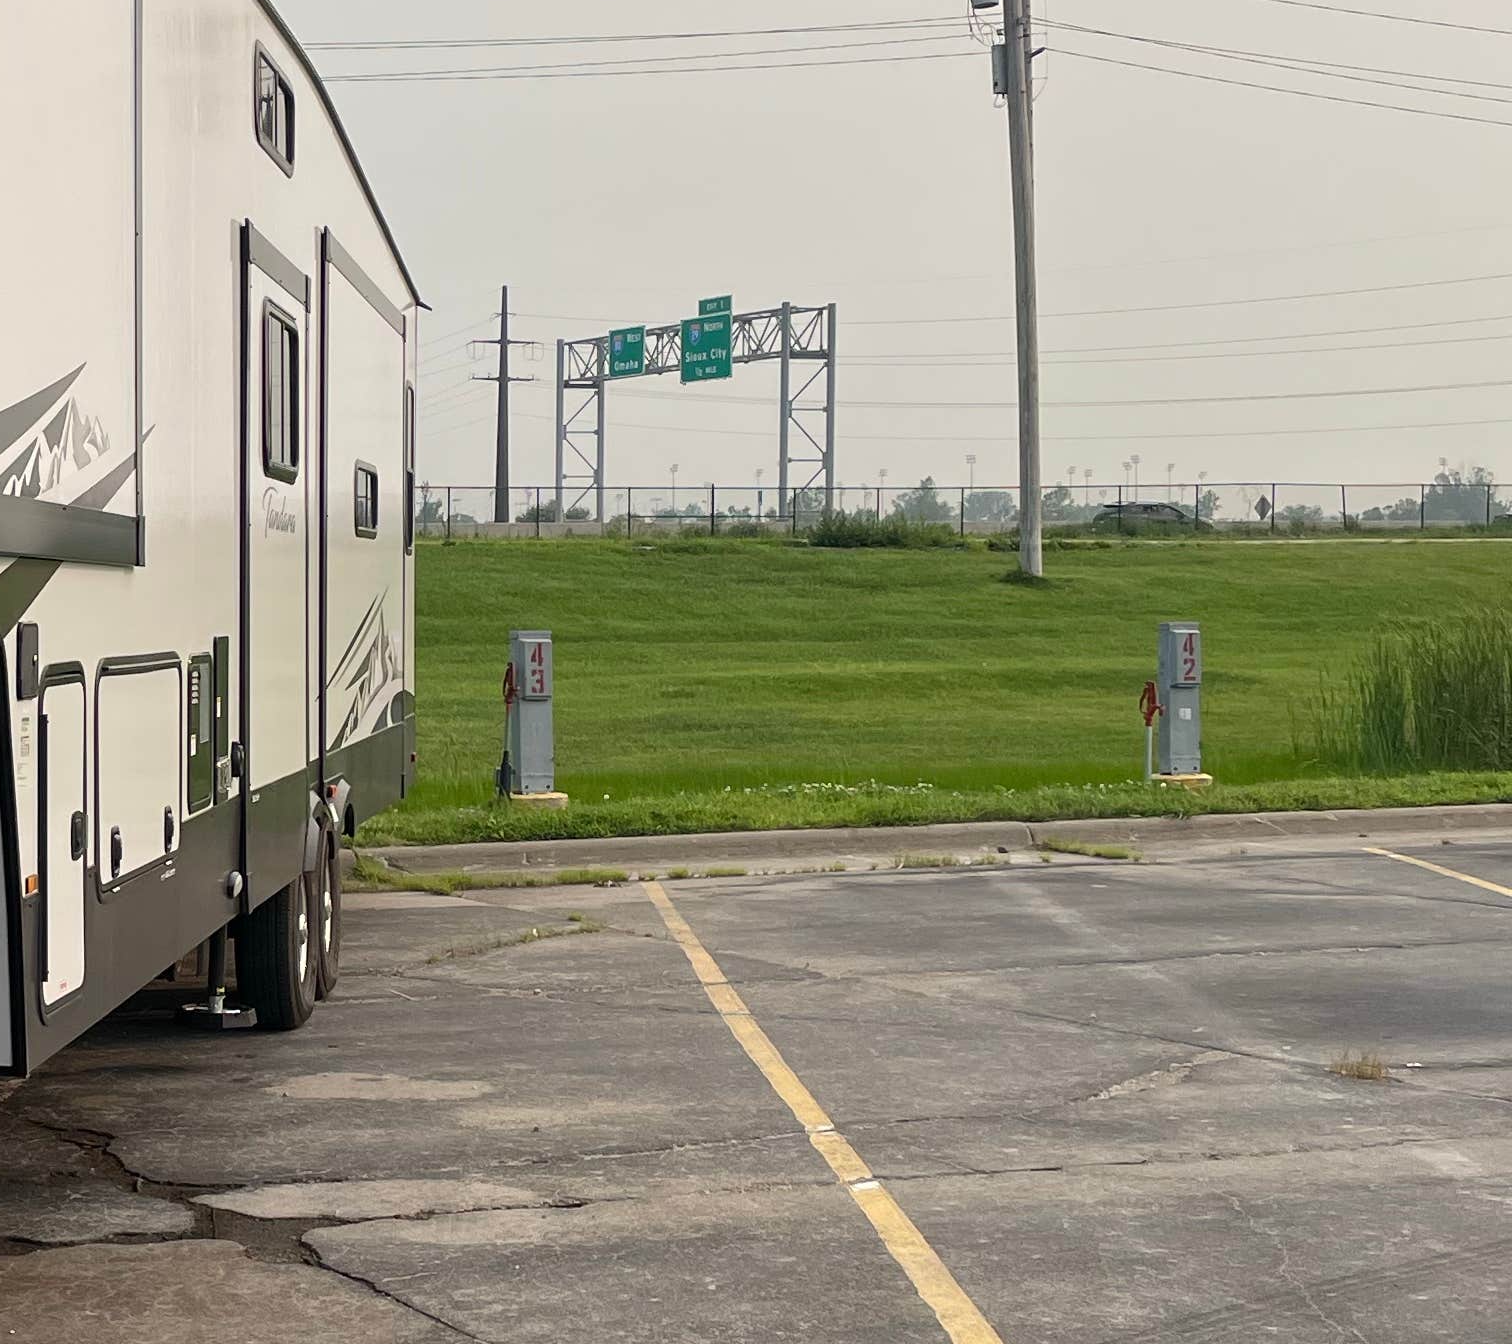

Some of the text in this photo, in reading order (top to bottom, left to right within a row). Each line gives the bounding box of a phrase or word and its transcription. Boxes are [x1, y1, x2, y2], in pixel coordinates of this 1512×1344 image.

[685, 347, 727, 363] Sioux City
[614, 359, 639, 371] Omaha
